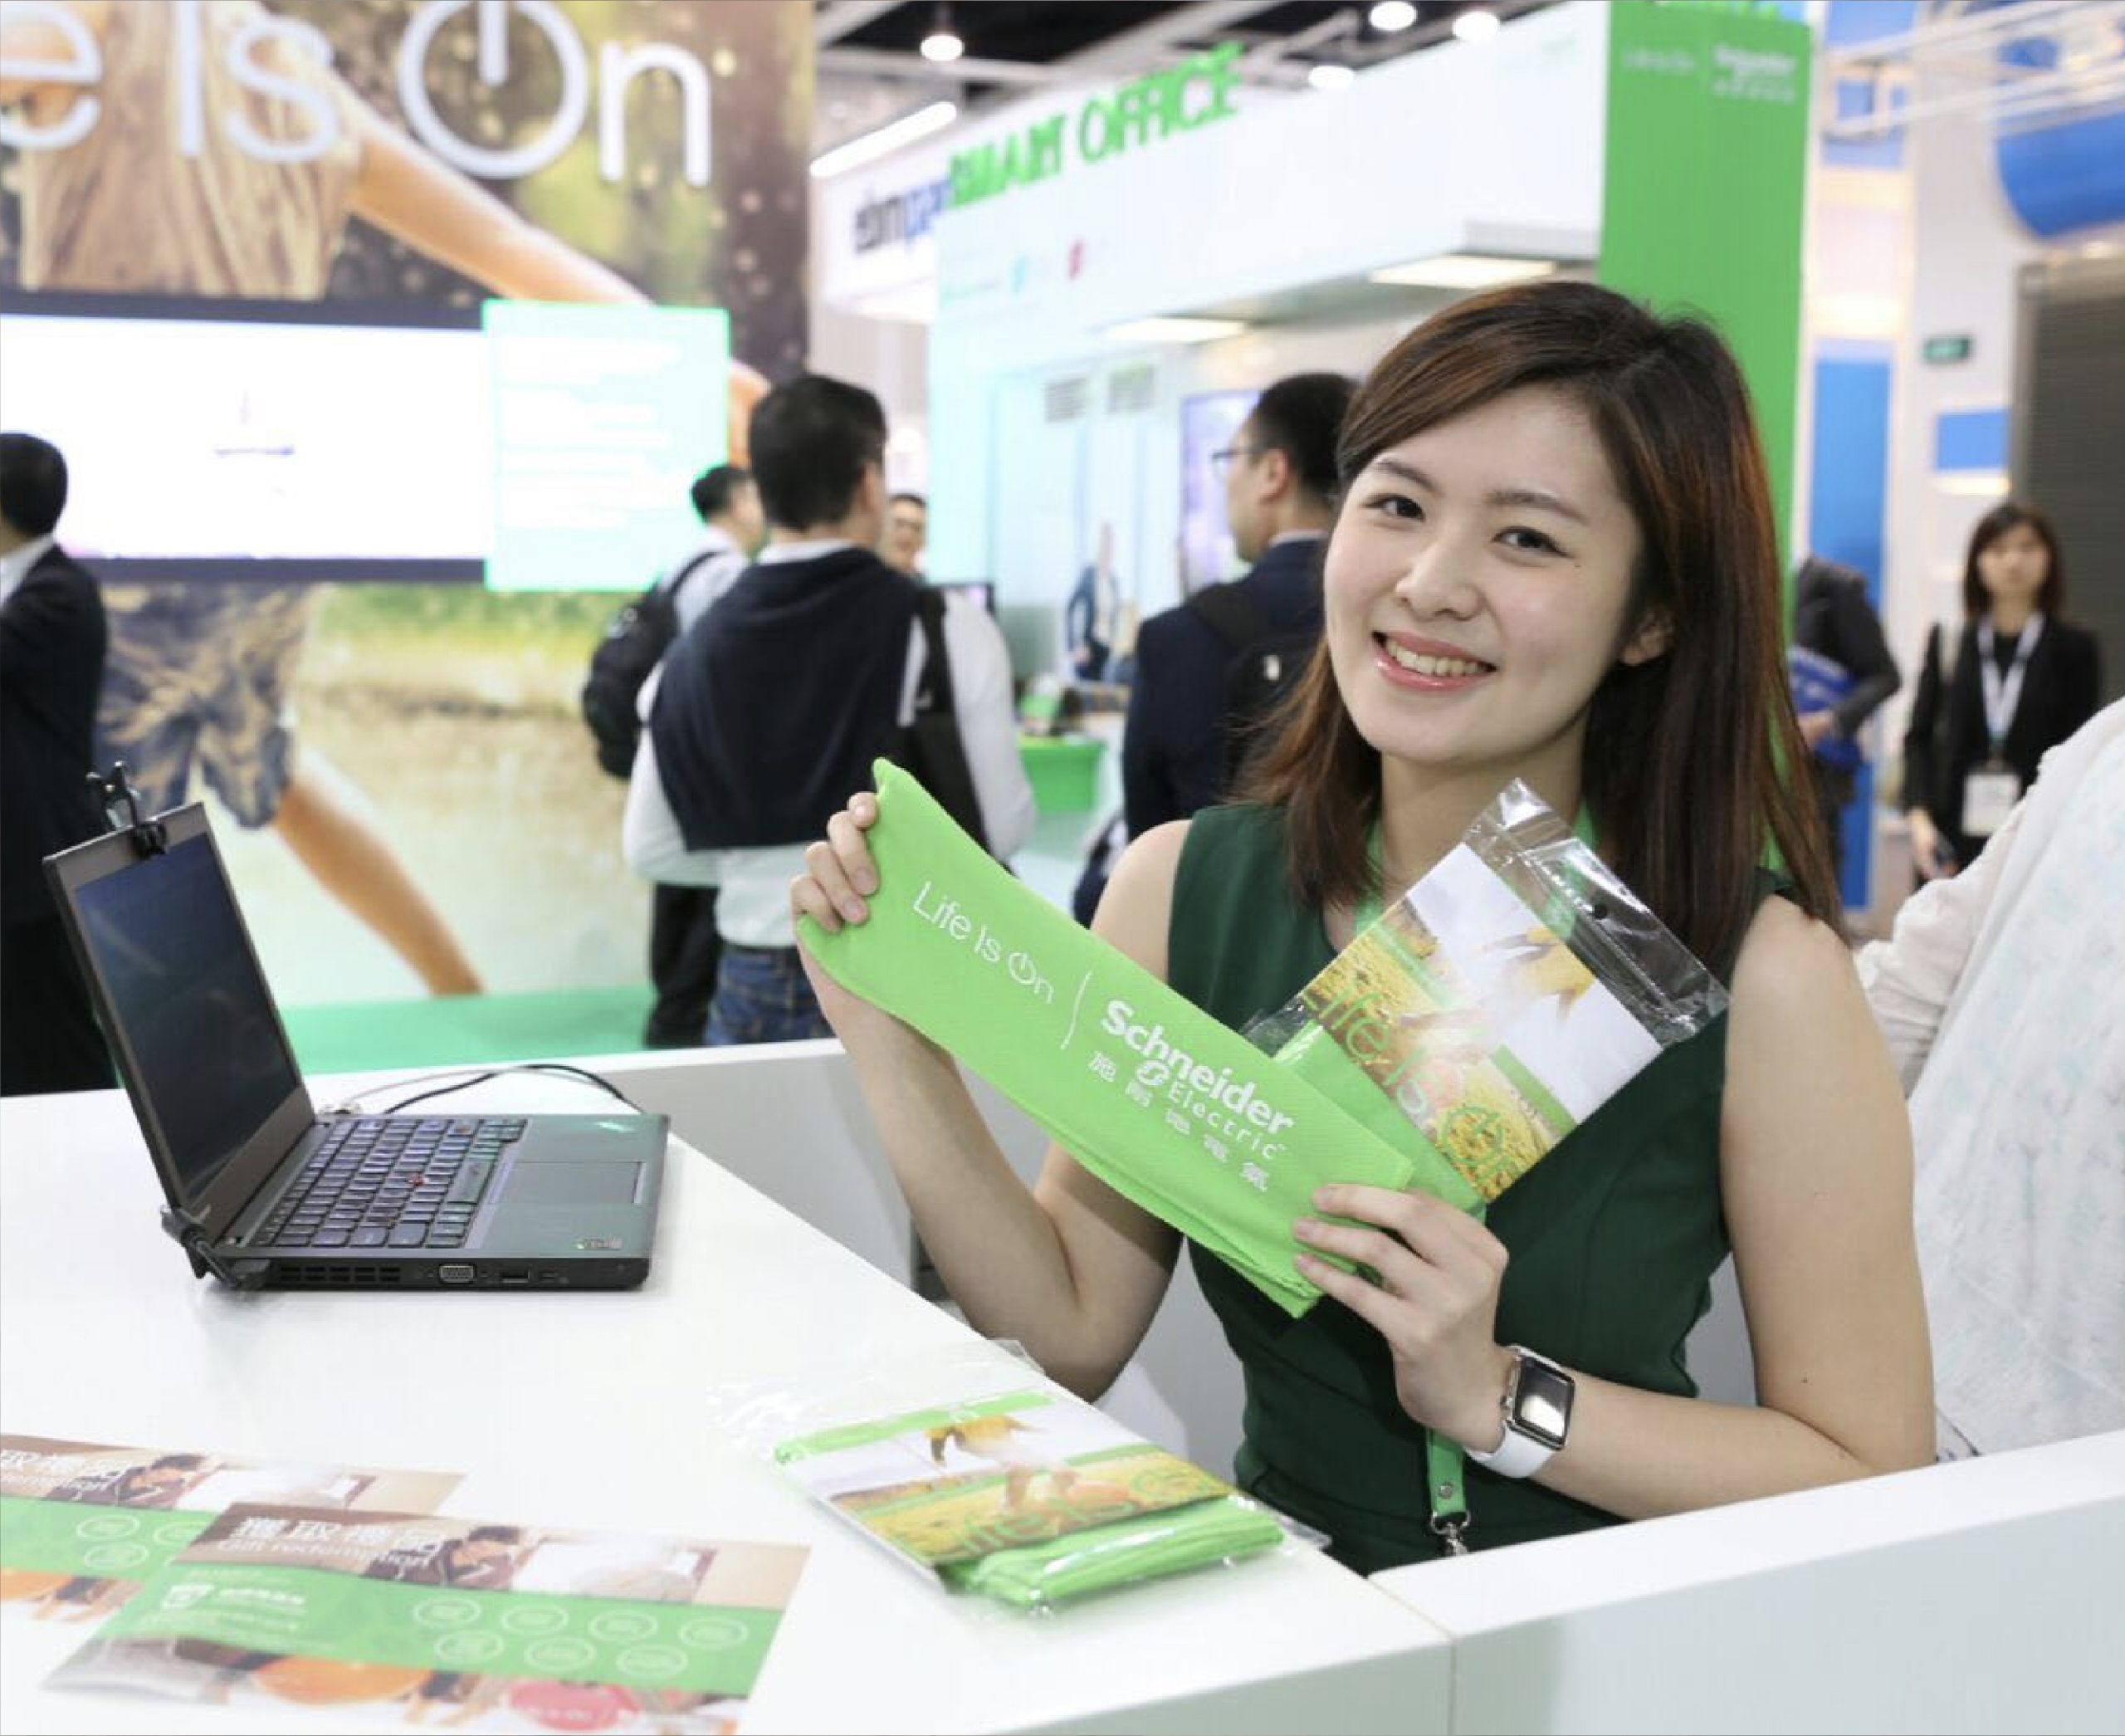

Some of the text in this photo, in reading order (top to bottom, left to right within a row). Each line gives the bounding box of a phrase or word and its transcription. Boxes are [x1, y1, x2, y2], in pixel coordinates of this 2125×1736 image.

[177, 0, 339, 162] Is
[398, 0, 711, 187] On
[912, 880, 1054, 1005] Life Is On
[1101, 1000, 1294, 1134] Schneider
[1168, 1081, 1278, 1160] Electric
